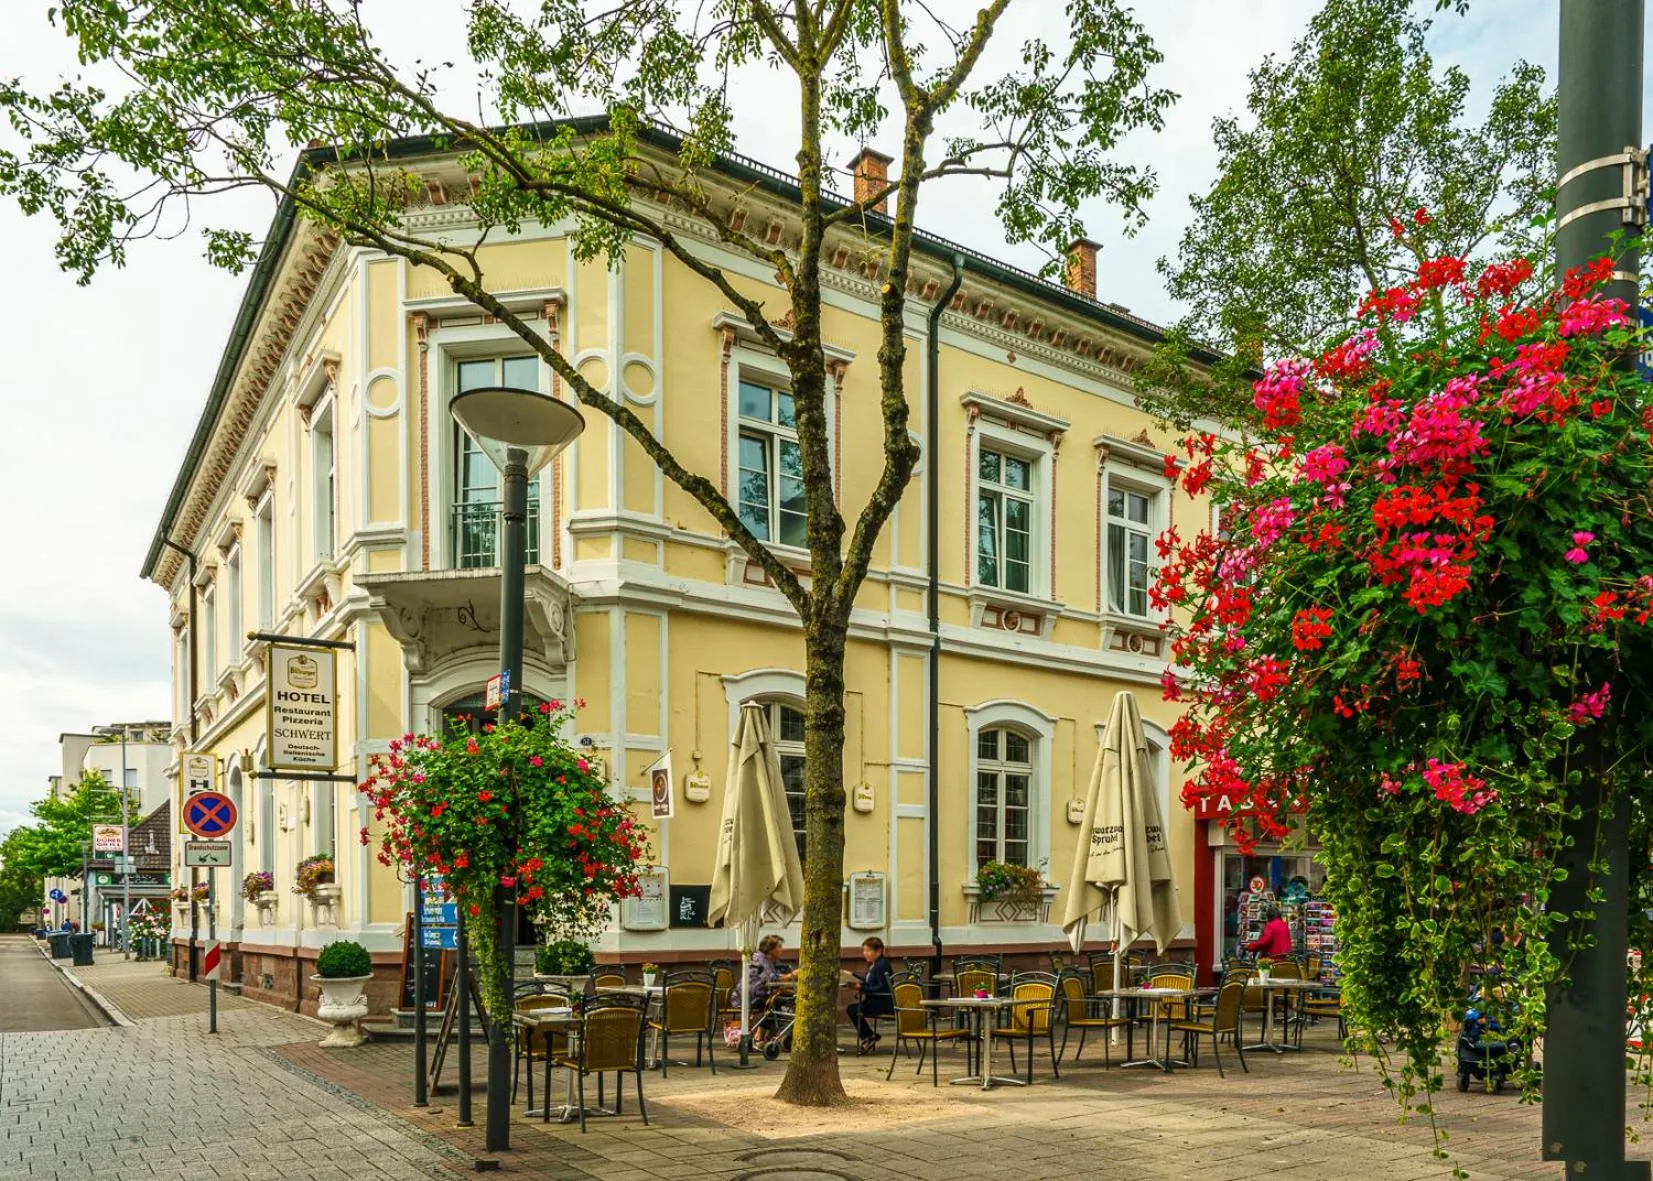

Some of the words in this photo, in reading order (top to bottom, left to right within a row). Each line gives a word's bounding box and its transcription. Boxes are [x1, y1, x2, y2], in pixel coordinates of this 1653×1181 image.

[277, 691, 331, 704] HOTEL
[274, 705, 331, 717] Restaurant
[282, 716, 323, 725] Pizzeria
[274, 728, 332, 740] SCHWERT
